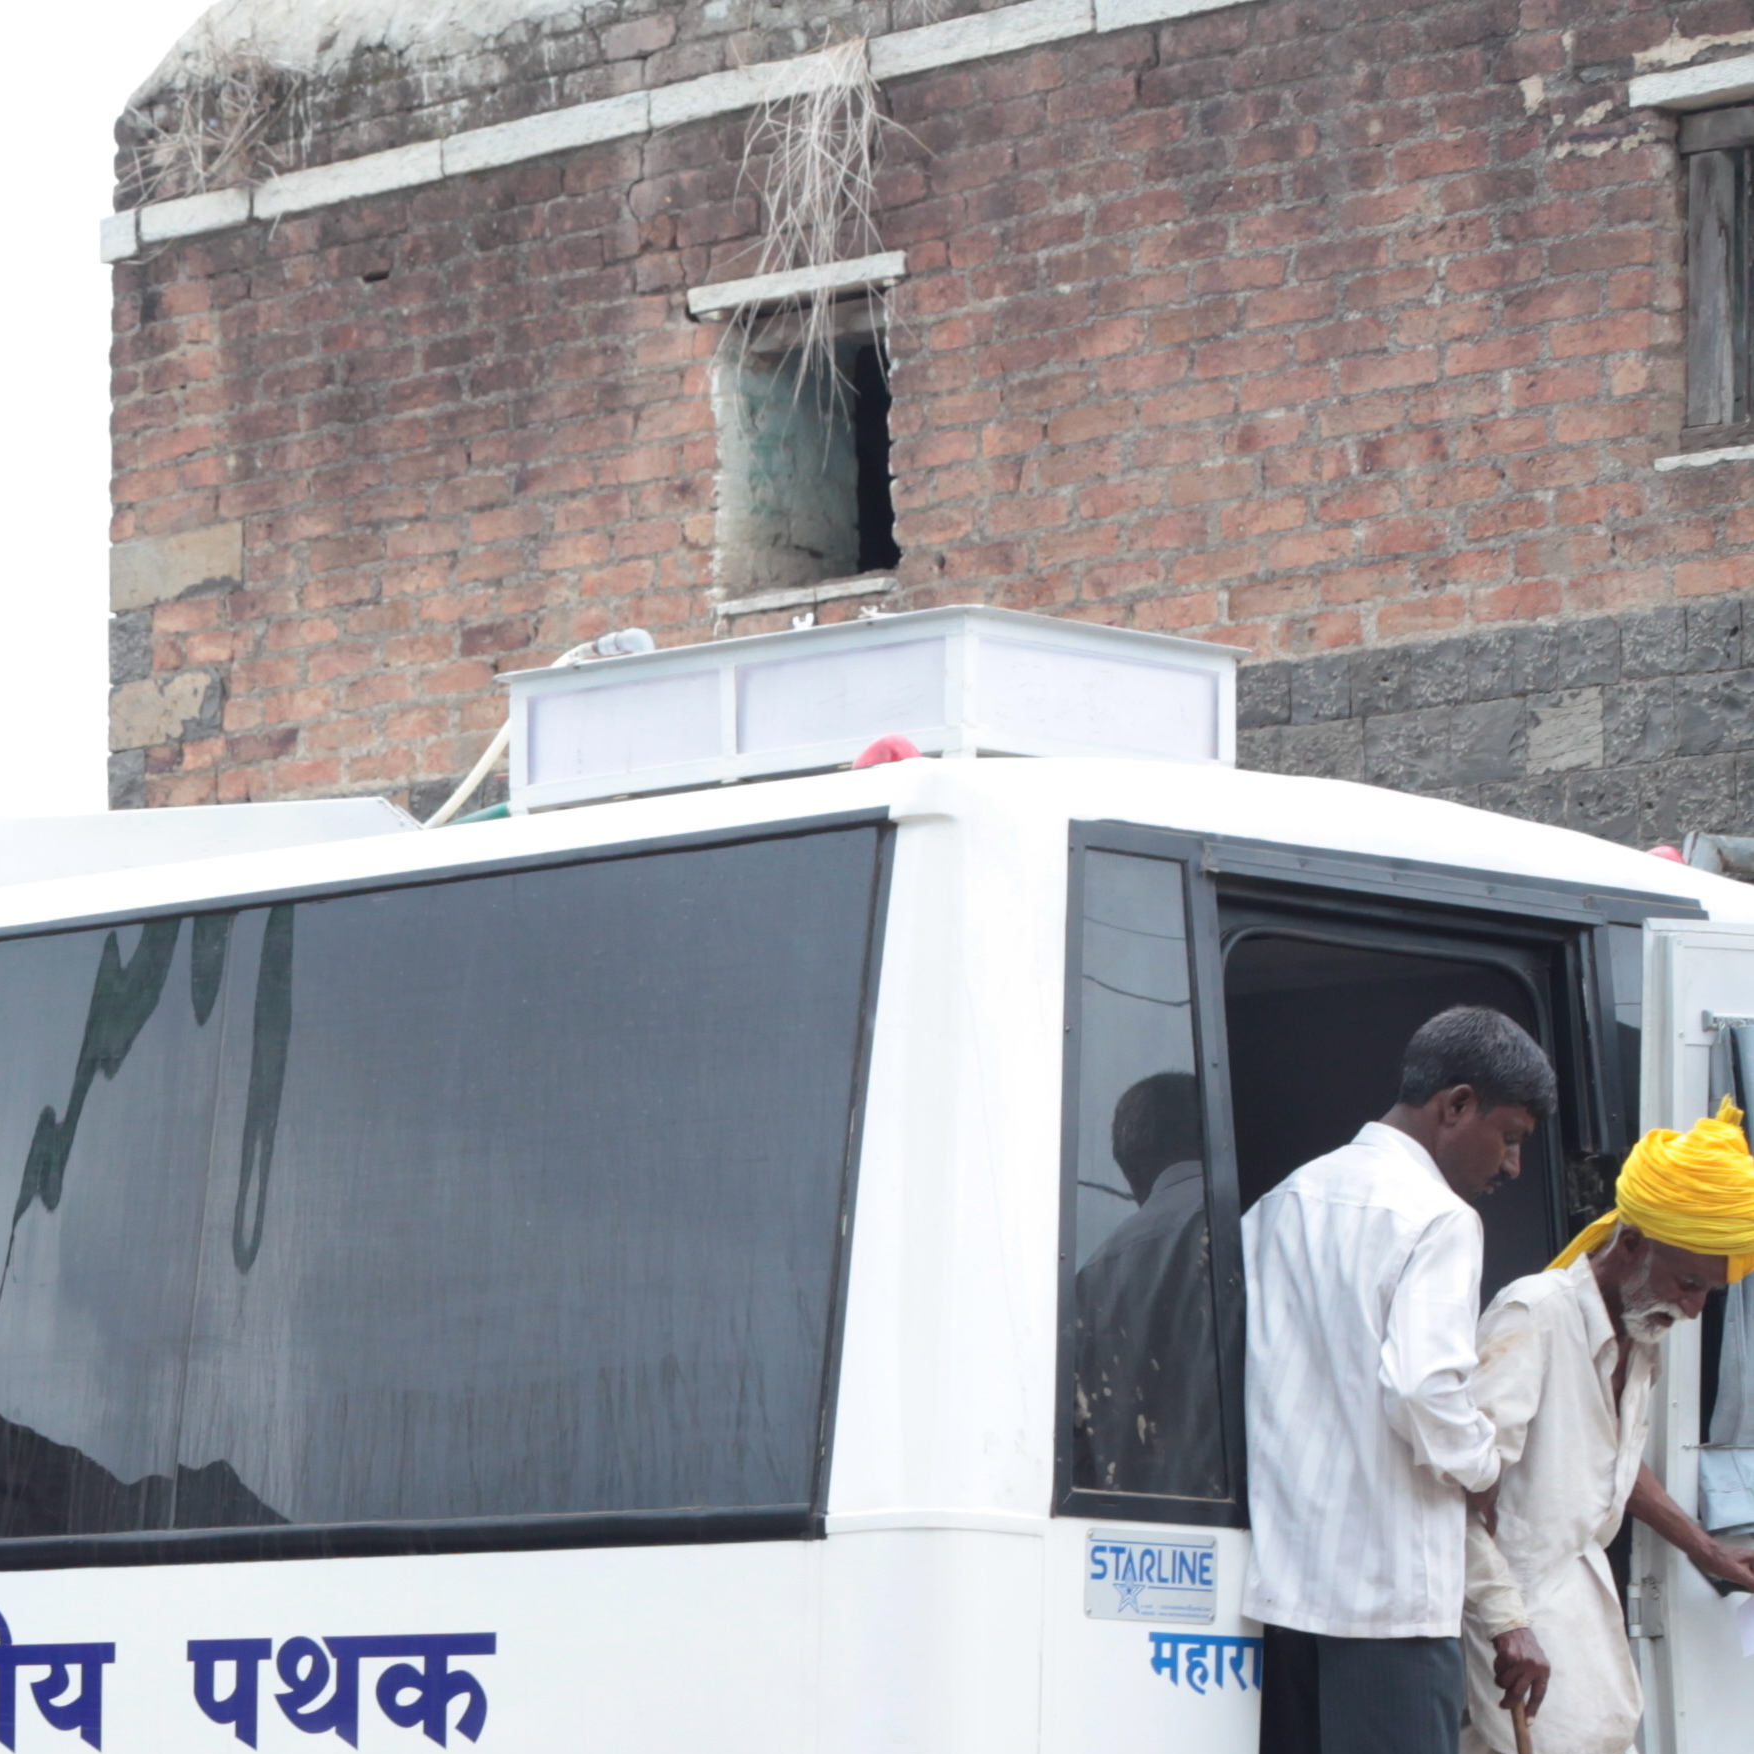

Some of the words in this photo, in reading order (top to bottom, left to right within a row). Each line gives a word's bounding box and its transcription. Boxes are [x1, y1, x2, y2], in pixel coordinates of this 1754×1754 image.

[1090, 1546, 1213, 1586] STARLINE
[187, 1632, 497, 1750] पथक
[1149, 1632, 1262, 1695] महारा
